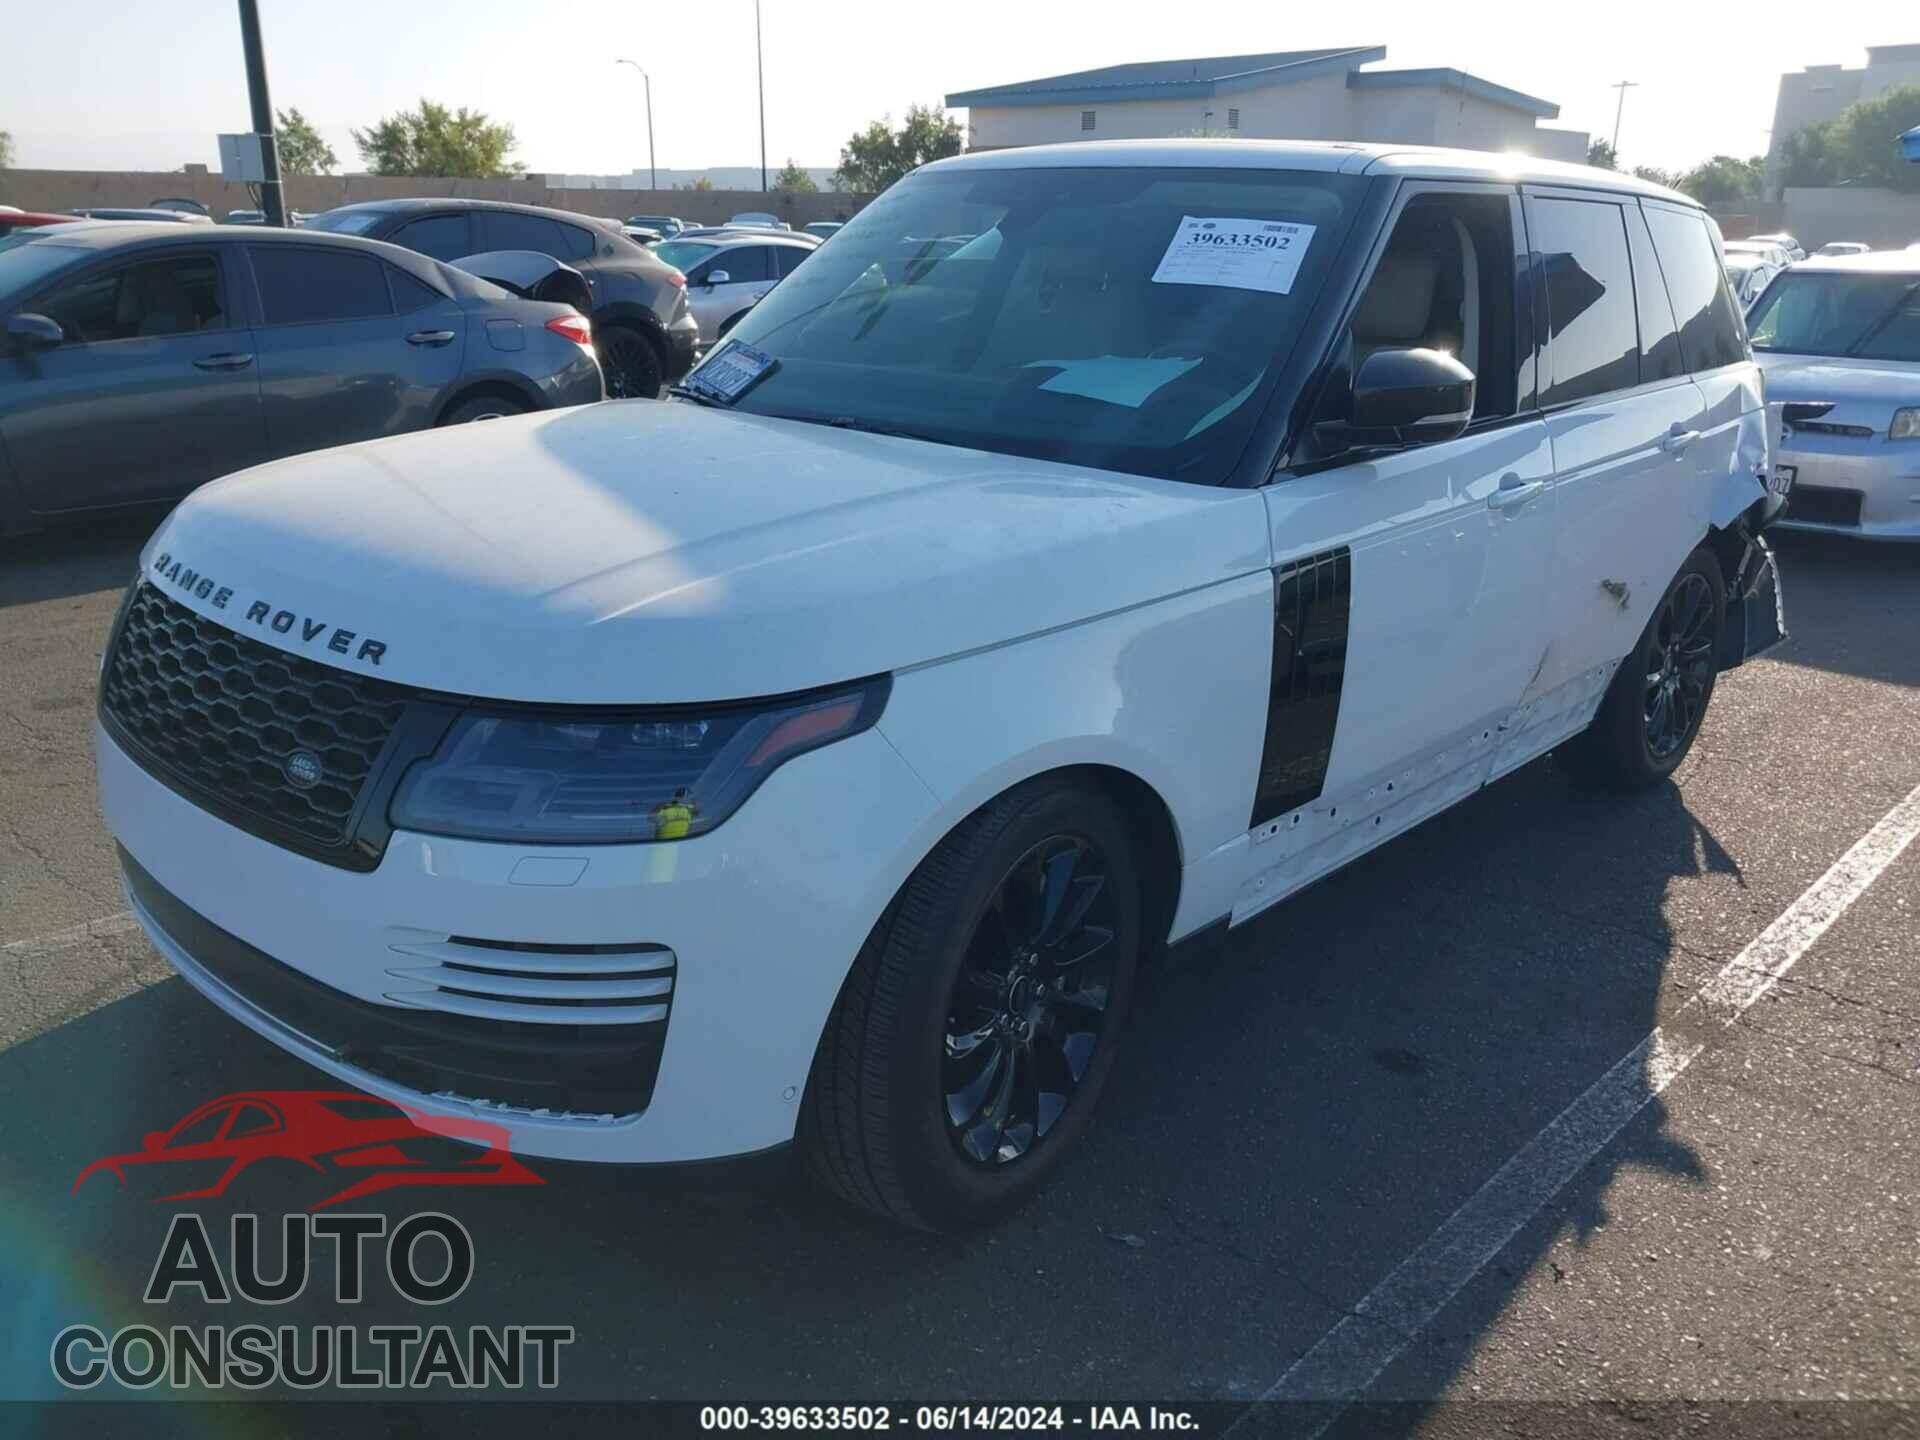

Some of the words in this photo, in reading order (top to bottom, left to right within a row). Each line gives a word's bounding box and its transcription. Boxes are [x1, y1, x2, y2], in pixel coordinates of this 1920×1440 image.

[1187, 232, 1291, 250] 39633502
[153, 553, 234, 609] RANGE
[245, 600, 388, 665] ROVER
